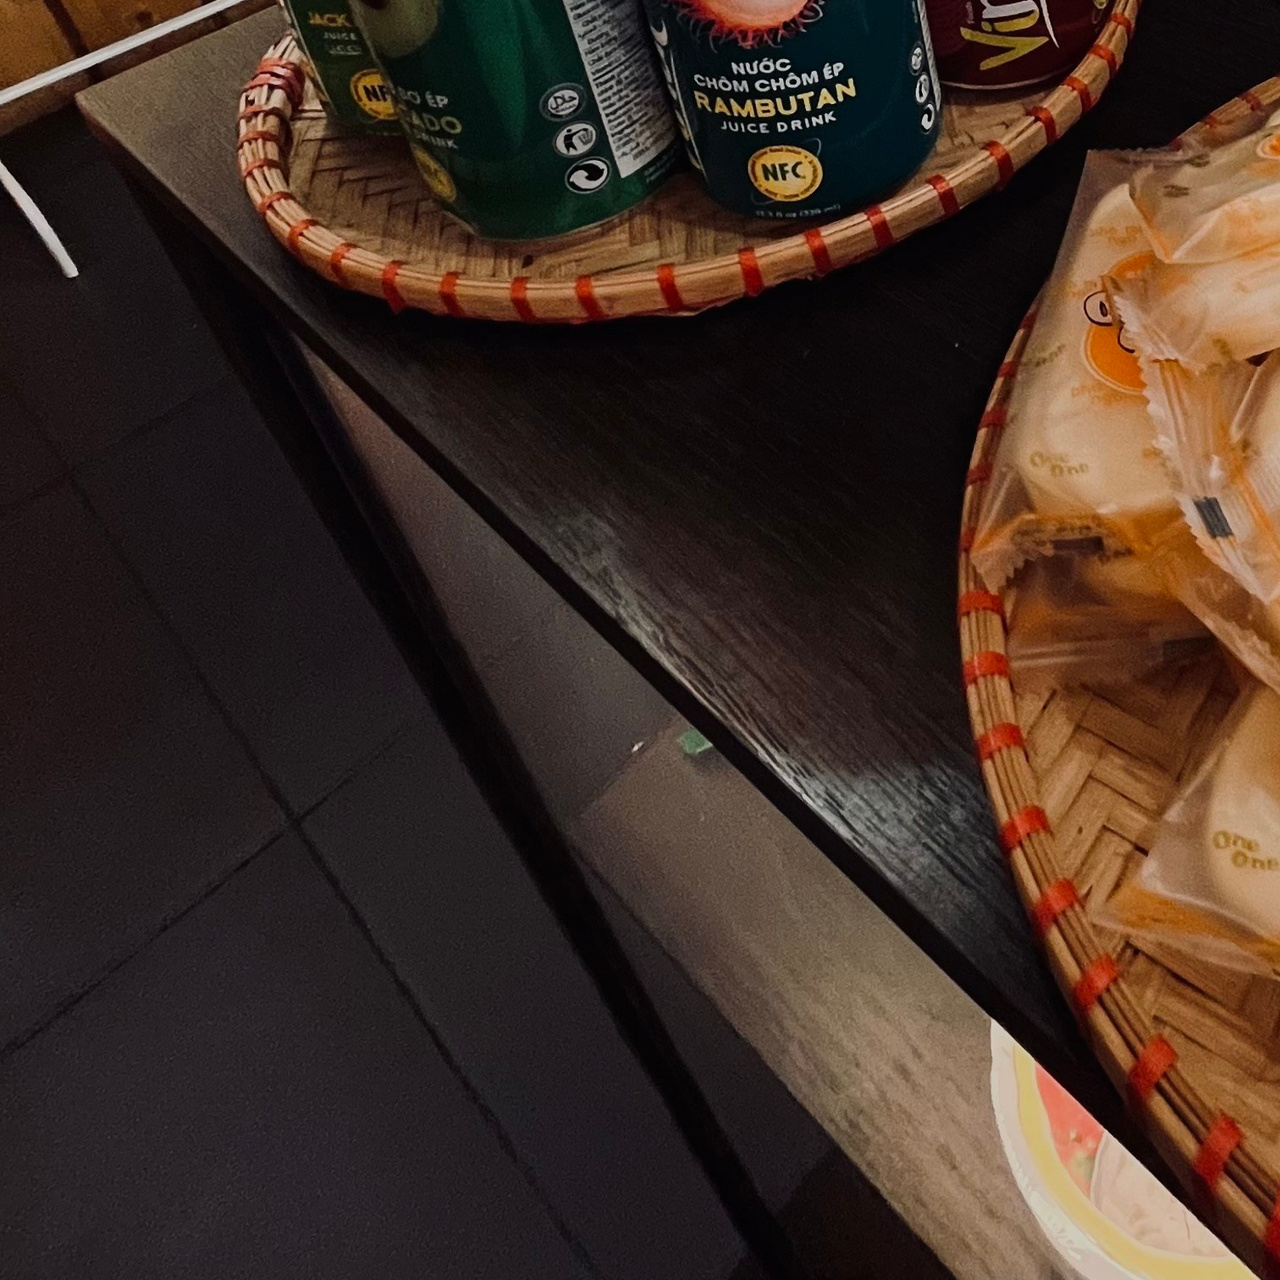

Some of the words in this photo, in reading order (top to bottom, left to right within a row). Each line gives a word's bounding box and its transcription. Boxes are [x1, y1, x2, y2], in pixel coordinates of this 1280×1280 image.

[693, 73, 749, 93] CHÔM
[754, 71, 819, 93] CHÔM
[823, 61, 845, 81] ÉP
[731, 57, 792, 76] NƯỚC
[693, 77, 858, 119] RAMBUTAN
[720, 121, 770, 134] JUICE
[776, 110, 838, 133] DRINK
[760, 160, 807, 182] NFC
